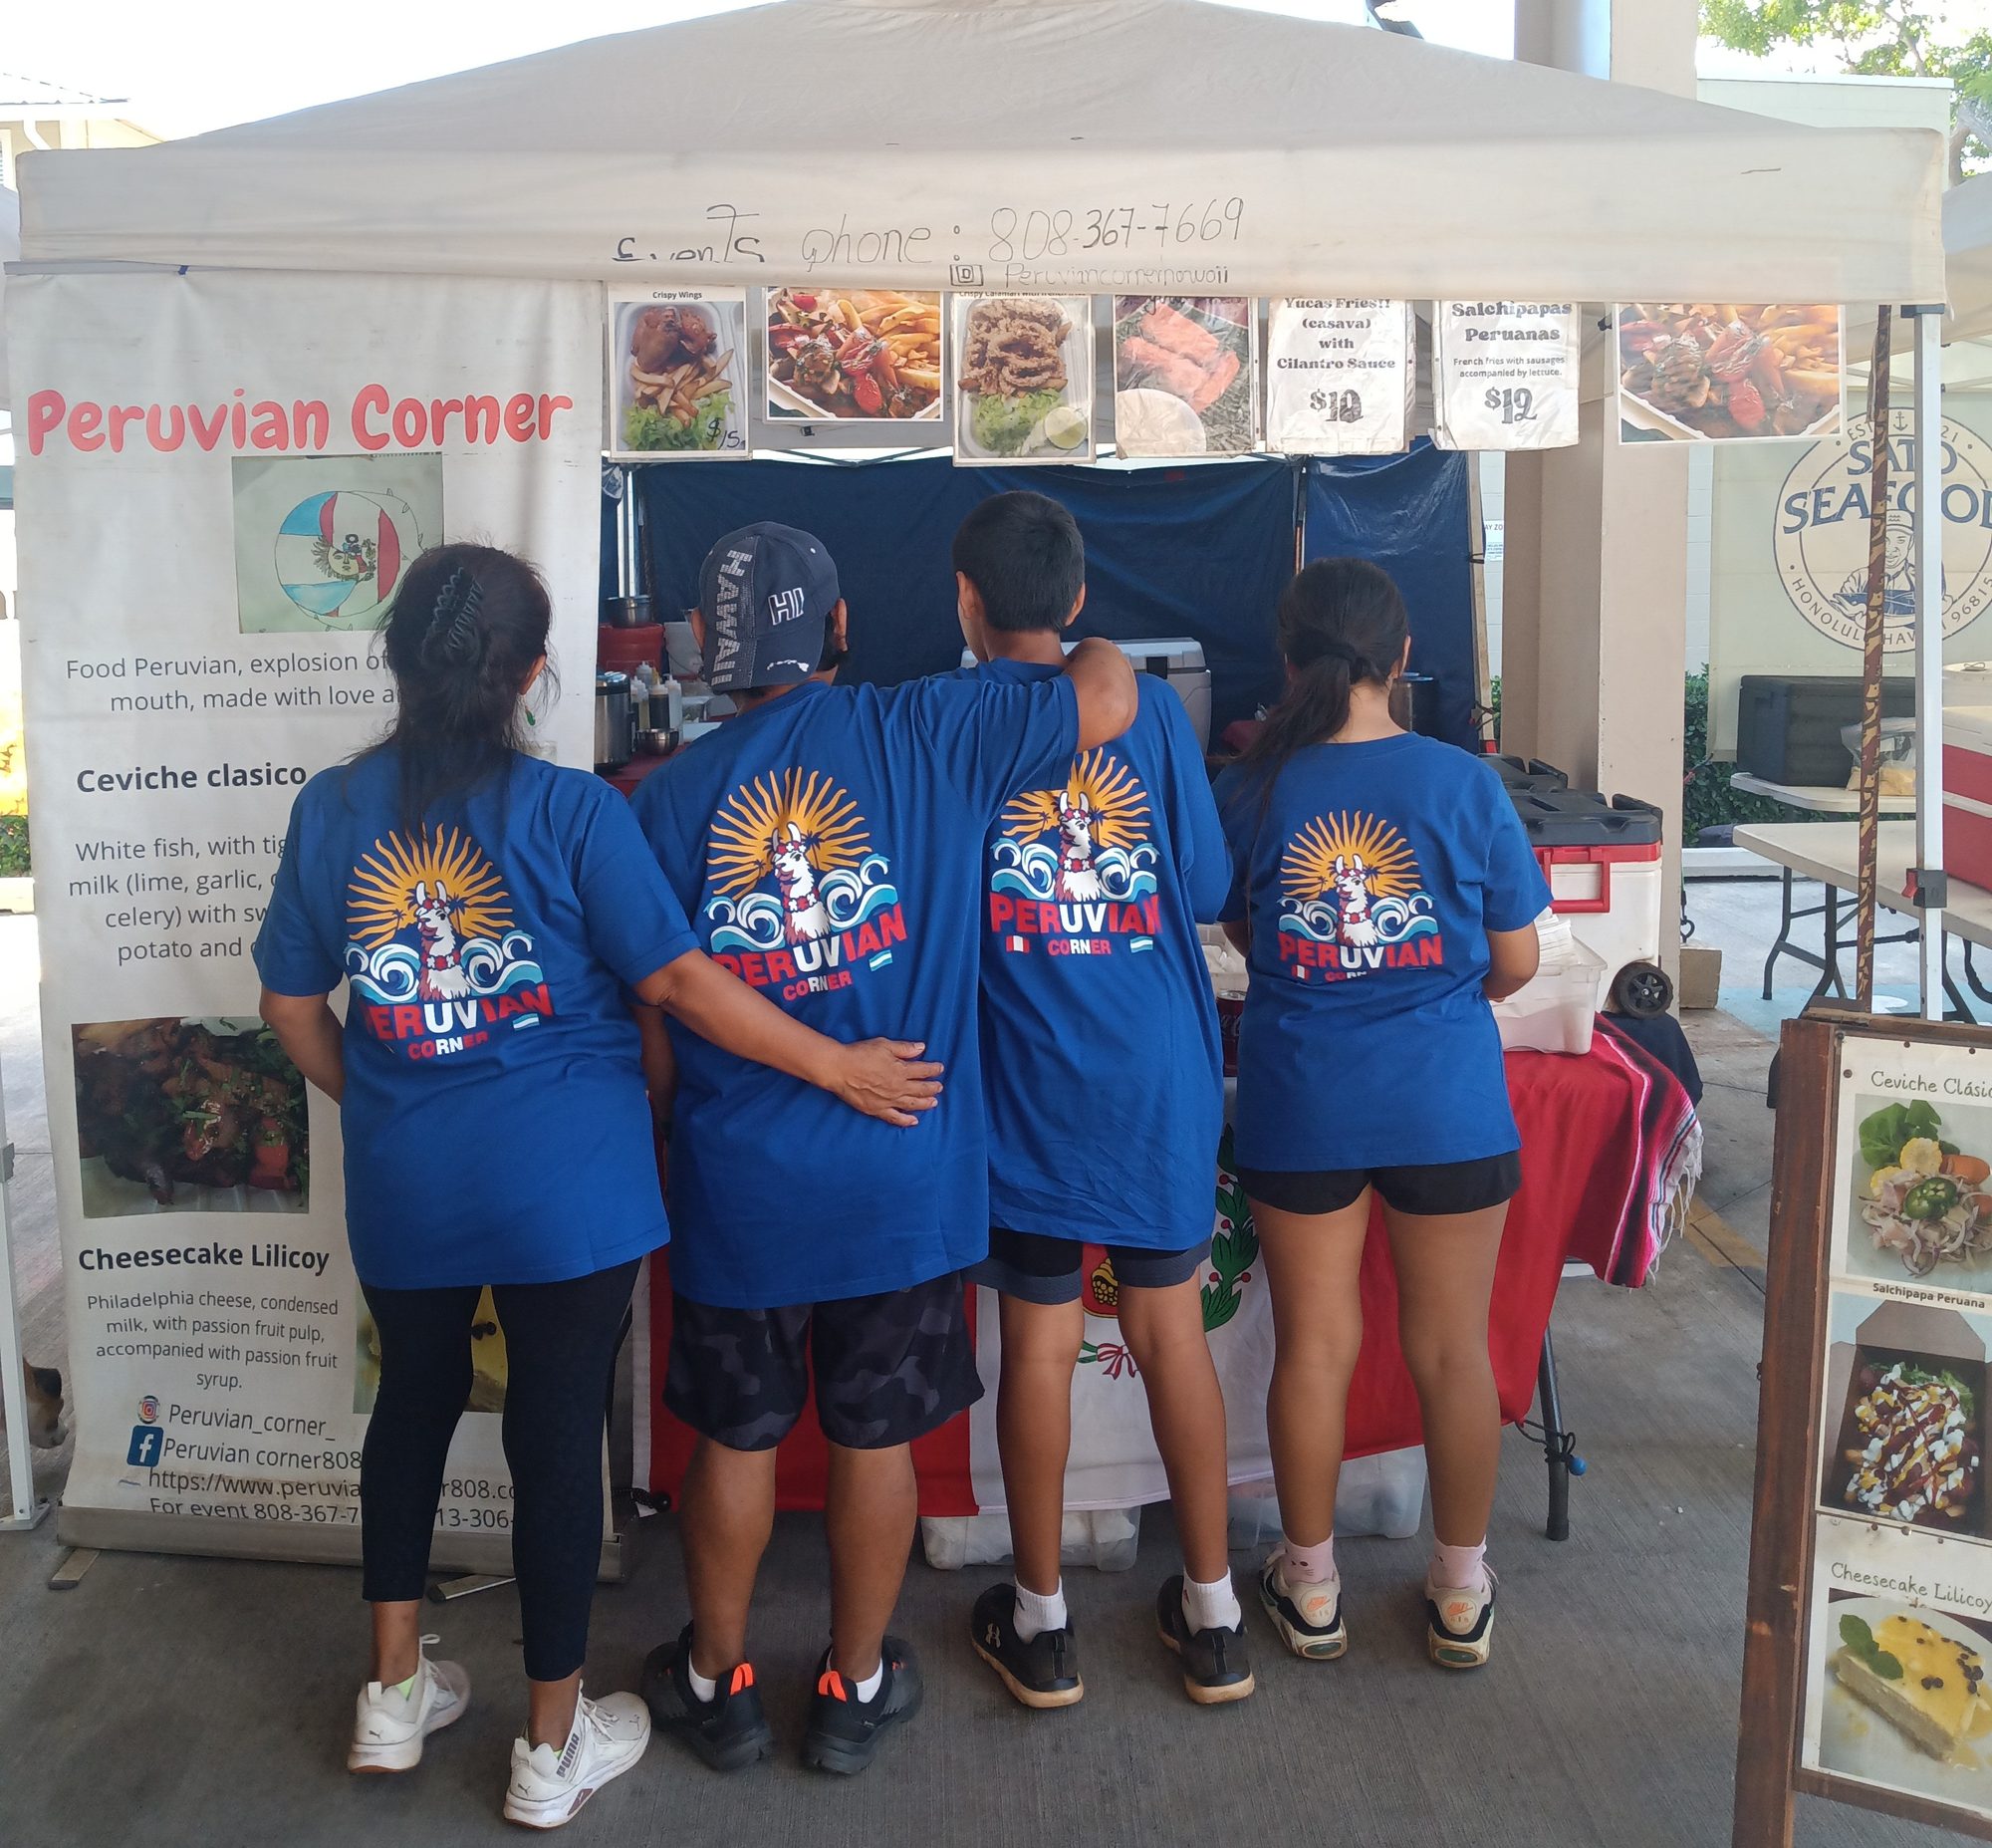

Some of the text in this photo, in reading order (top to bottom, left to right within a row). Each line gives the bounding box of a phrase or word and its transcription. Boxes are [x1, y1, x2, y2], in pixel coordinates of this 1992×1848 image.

[652, 291, 703, 300] Crispy Wings
[1285, 297, 1333, 309] Yucas
[1302, 318, 1371, 329] (casava)
[1451, 301, 1573, 319] Salchipapas
[1319, 337, 1355, 349] with
[1464, 328, 1561, 342] Peruanas
[1277, 357, 1396, 370] Cilantro Sauce
[1453, 356, 1566, 367] French fries with sausages
[1459, 369, 1515, 379] accompanied
[1517, 368, 1527, 379] by
[1484, 387, 1538, 424] $12
[28, 384, 574, 456] Peruvian Corner
[710, 549, 753, 686] HAWAII
[768, 587, 805, 626] HI
[67, 659, 125, 679] Food
[134, 657, 243, 677] Peruvian,
[249, 653, 358, 677] explosion
[111, 690, 195, 712] mouth,
[203, 687, 267, 708] made
[274, 685, 322, 706] with
[329, 684, 374, 705] love
[77, 762, 308, 793] Ceviche clasico
[76, 840, 146, 862] White
[154, 838, 200, 861] fish,
[207, 836, 256, 856] with
[69, 875, 120, 896] milk
[126, 873, 189, 897] (lime,
[196, 870, 263, 896] garlic,
[106, 906, 182, 930] celery)
[188, 904, 236, 924] with
[989, 892, 1162, 935] PERUVIAN
[118, 939, 193, 966] potato
[200, 937, 242, 957] and
[1047, 938, 1113, 956] CORNER
[1277, 931, 1443, 969] PERUVIAN
[782, 969, 854, 1001] CORNER
[1870, 1070, 1938, 1093] Ceviche
[79, 1242, 330, 1276] Cheesecake Lilicoy
[88, 1291, 339, 1315] Philadelphia cheese, condensed
[1872, 1282, 1985, 1309] Salchipapa Peruana
[107, 1316, 325, 1344] milk, with passion fruit pulp,
[96, 1342, 338, 1369] accompanied with passion fruit
[196, 1372, 243, 1392] syrup.
[168, 1404, 336, 1442] Peruvian_corner_
[163, 1438, 362, 1470] Peruvian corner808
[149, 1497, 183, 1514] For
[190, 1501, 249, 1520] event
[1831, 1562, 1992, 1614] Cheesecake Lilicoy
[555, 1731, 581, 1779] PUMA
